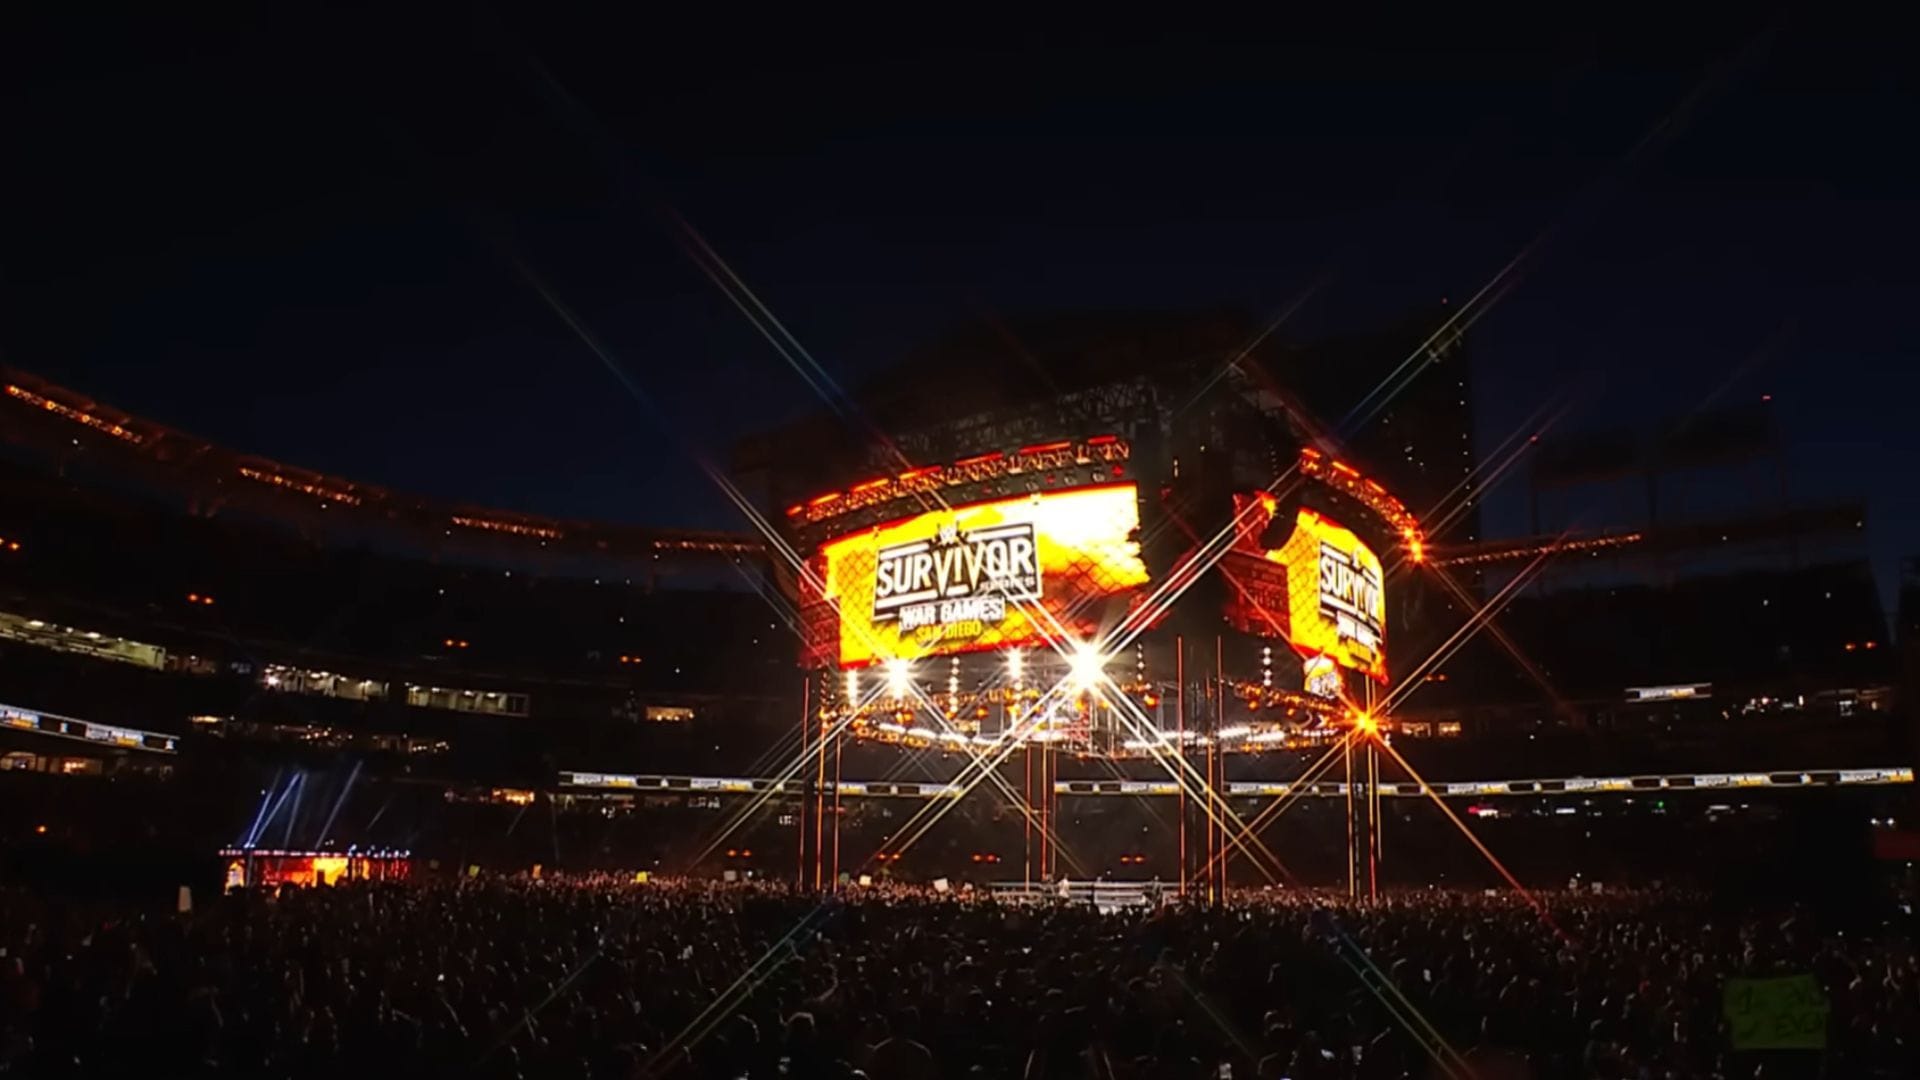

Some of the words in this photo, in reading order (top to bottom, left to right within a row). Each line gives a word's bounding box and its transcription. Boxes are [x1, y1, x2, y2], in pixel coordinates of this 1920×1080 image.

[876, 538, 1034, 597] SURVIVOR
[901, 607, 936, 629] WAR
[940, 597, 1002, 622] GAMES
[945, 620, 983, 639] DIEGO
